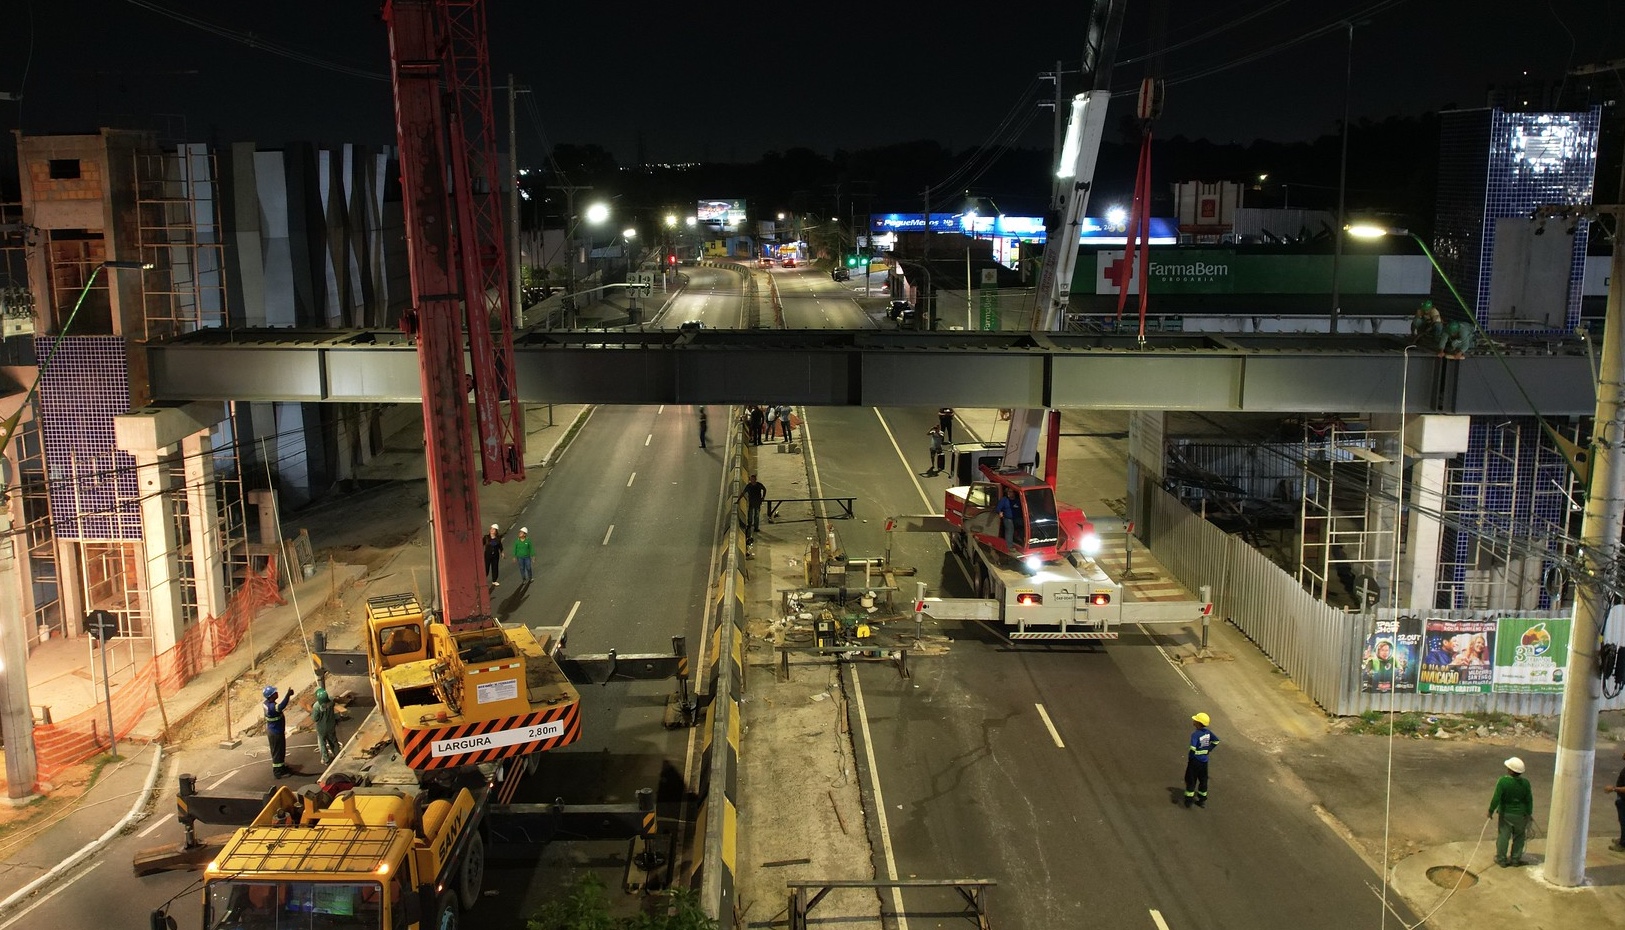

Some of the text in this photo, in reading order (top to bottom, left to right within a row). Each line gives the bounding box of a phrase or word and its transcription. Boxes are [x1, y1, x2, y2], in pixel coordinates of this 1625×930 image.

[884, 219, 939, 227] PagueMeos
[1149, 262, 1228, 276] FarmaBem
[1397, 634, 1422, 642] 22.OUT
[1421, 669, 1460, 685] INVOCAÇÃO
[1429, 684, 1454, 692] ENTRADA
[438, 725, 557, 752] LARGURA 2,80m
[439, 807, 462, 865] SANY
